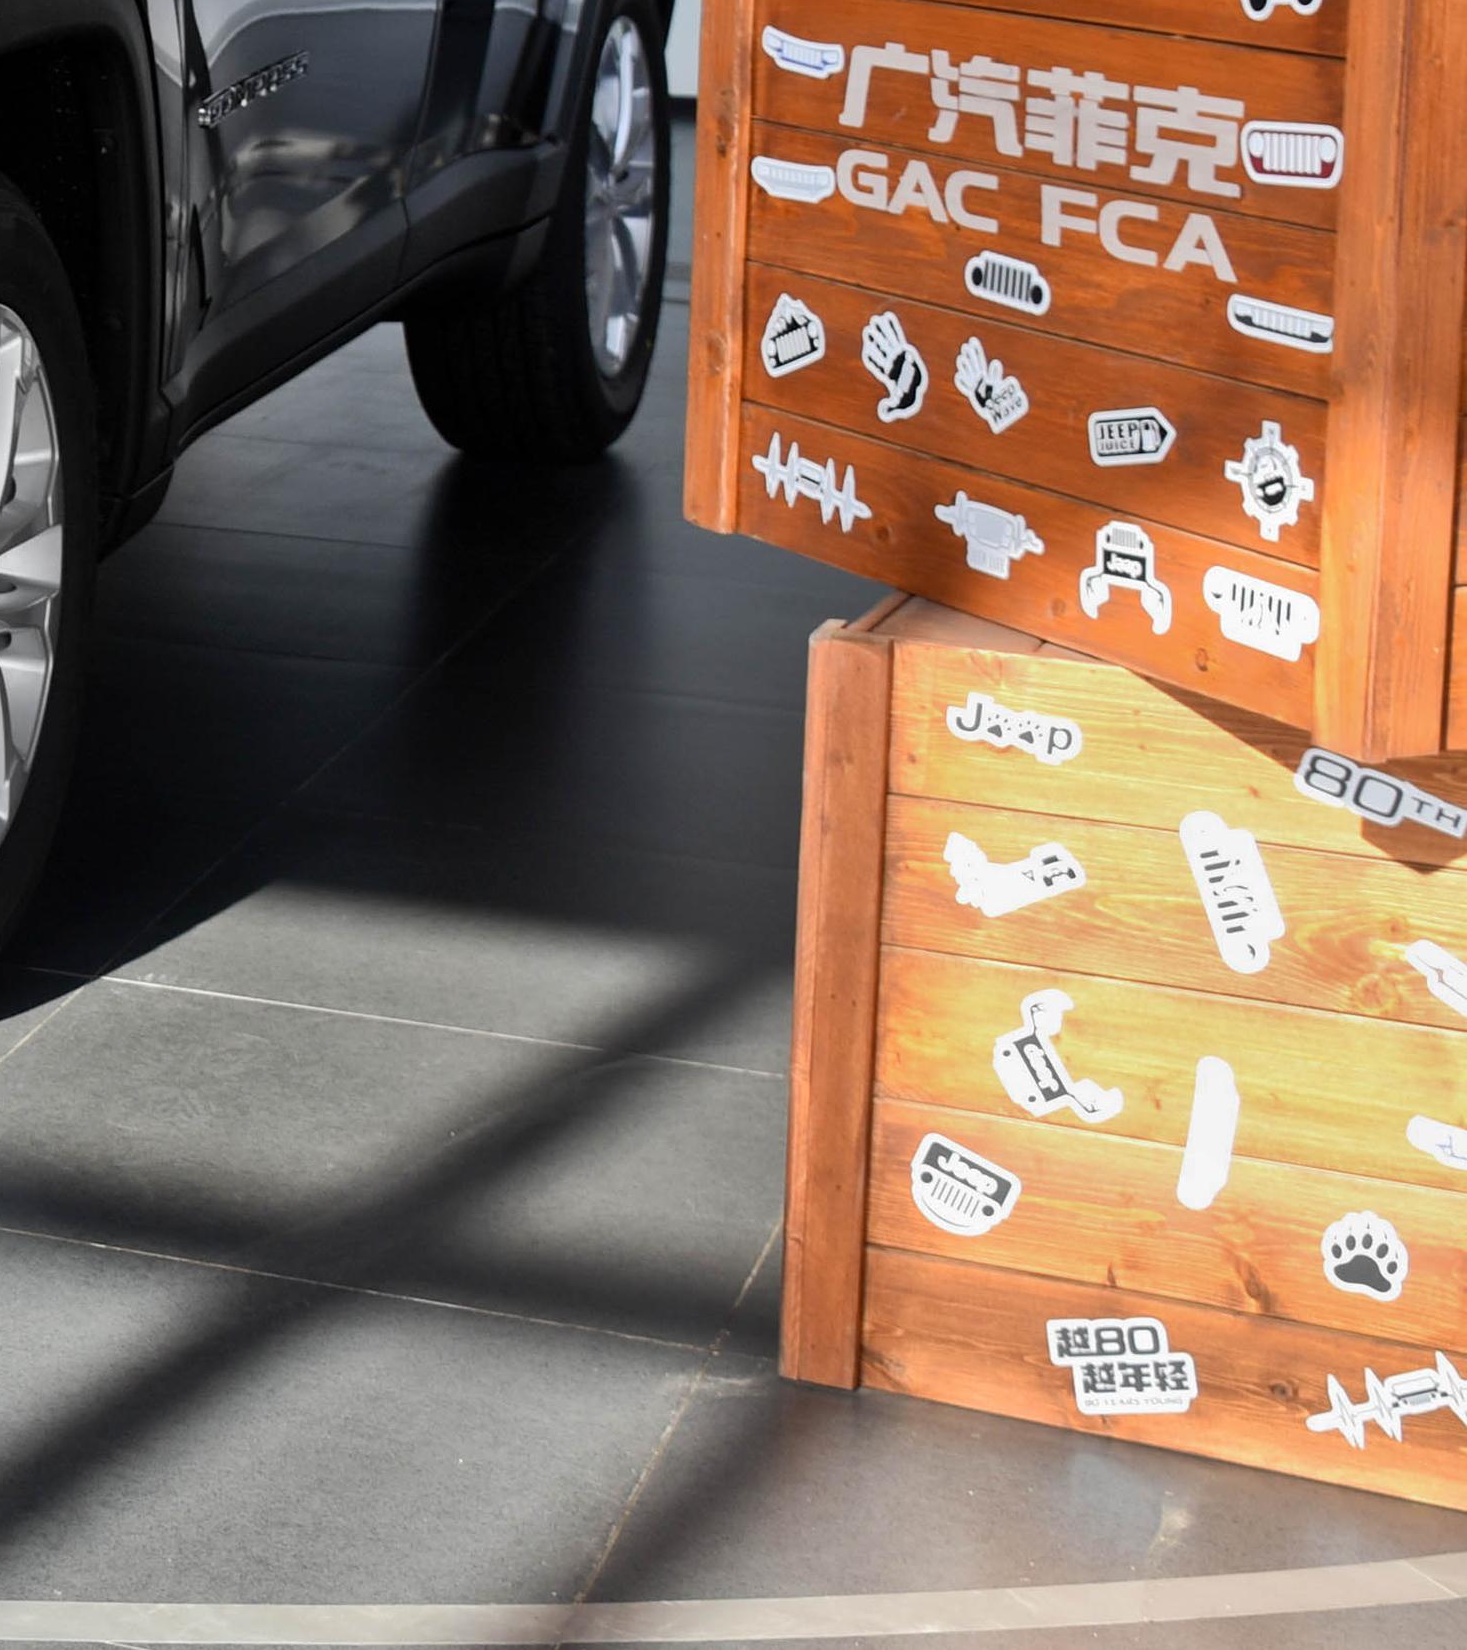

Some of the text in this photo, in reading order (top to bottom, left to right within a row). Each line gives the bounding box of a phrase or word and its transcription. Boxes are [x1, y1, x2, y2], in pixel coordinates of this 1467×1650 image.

[837, 41, 1244, 198] 广汽菲克
[836, 149, 1238, 283] GAC FCA
[1099, 423, 1139, 440] JEEP
[1100, 439, 1137, 452] JUICE
[1106, 553, 1143, 578] Jeep
[937, 1152, 998, 1196] Jeep
[1055, 1325, 1160, 1358] 越80
[1080, 1360, 1189, 1393] 越年轻
